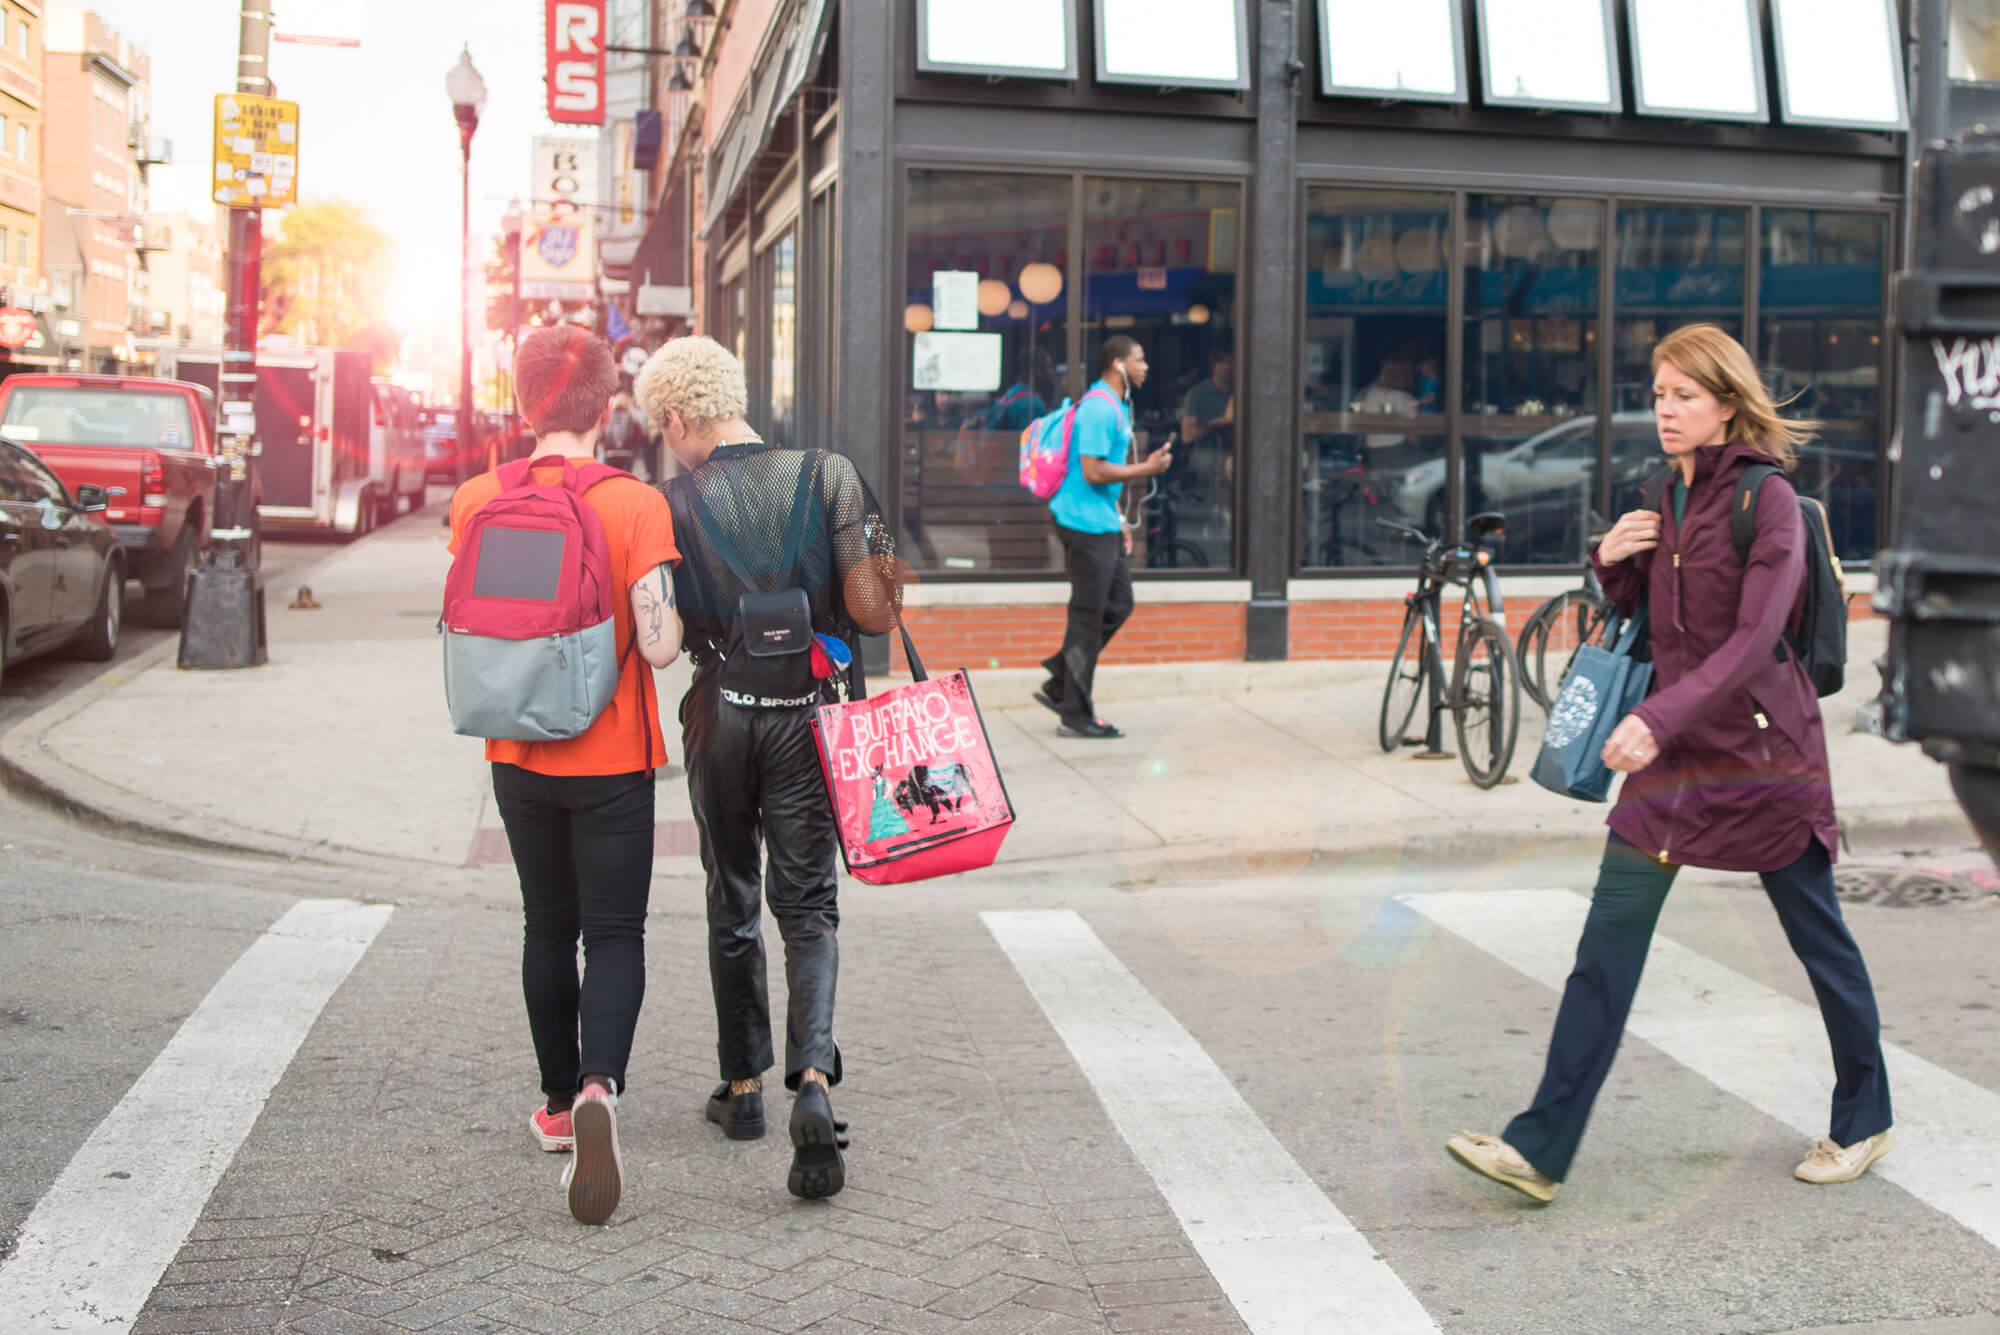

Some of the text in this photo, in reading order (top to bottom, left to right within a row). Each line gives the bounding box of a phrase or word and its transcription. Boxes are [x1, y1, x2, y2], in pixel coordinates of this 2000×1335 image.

[720, 687, 816, 707] OLO SPORT
[851, 692, 950, 747] BUFFALO
[839, 716, 977, 781] EXCHANGE
